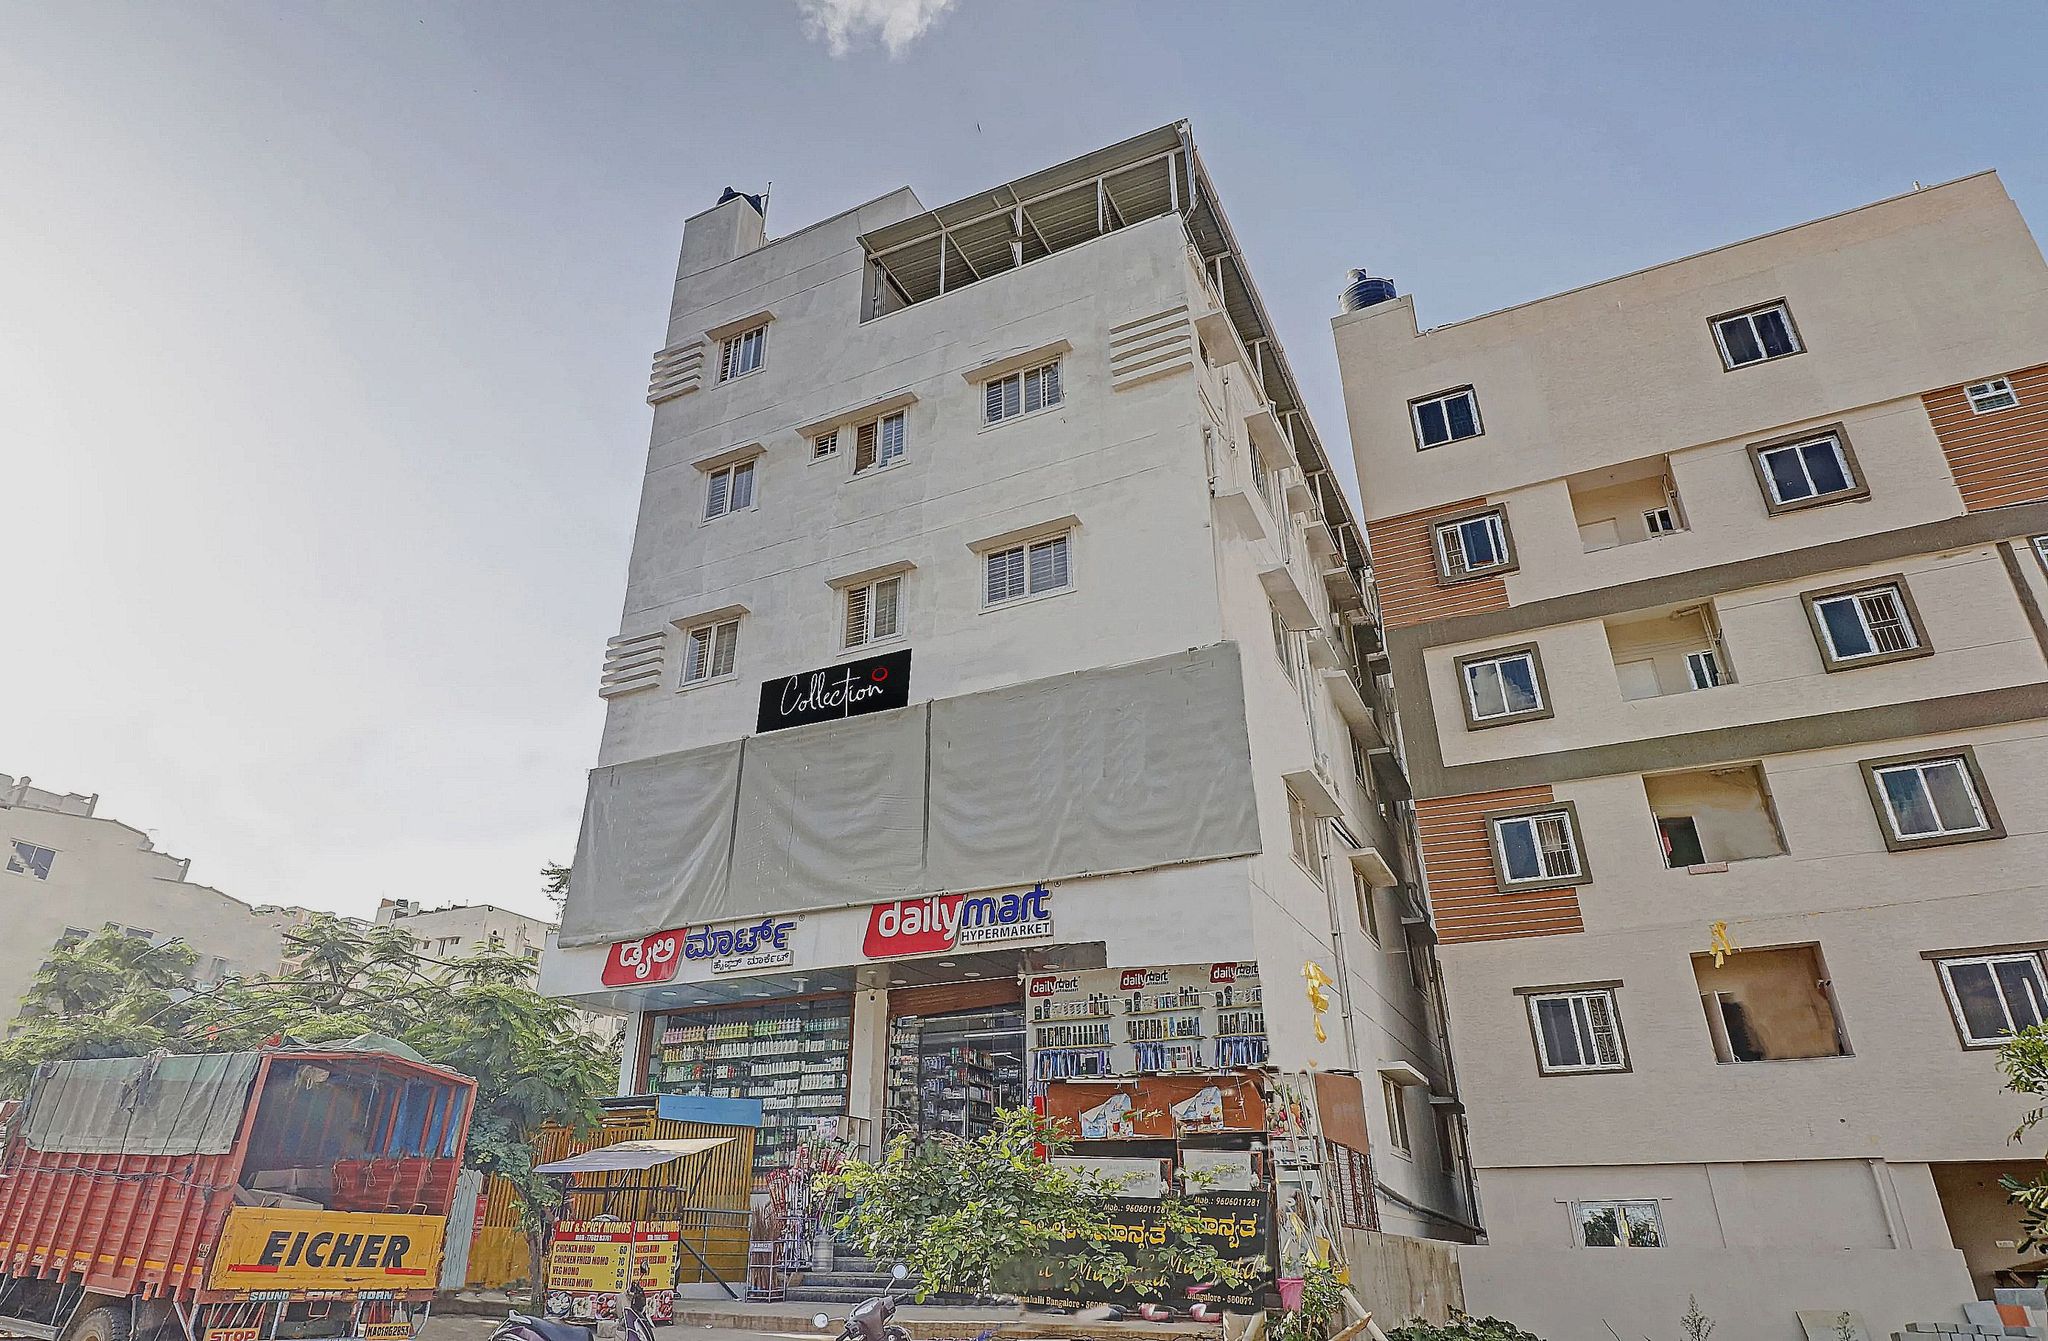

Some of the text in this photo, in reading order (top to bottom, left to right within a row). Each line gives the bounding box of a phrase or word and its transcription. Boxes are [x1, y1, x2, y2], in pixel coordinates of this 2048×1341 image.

[780, 667, 884, 718] Collection
[961, 922, 1051, 942] HYPERMARKET
[1216, 1197, 1261, 1207] 9606011281
[560, 1221, 632, 1234] HOT & SPICY MOMOS
[256, 1230, 411, 1268] EICHER
[555, 1244, 578, 1253] CHICKEN
[578, 1245, 596, 1254] MOMO
[554, 1255, 577, 1264] CHICKEN
[577, 1256, 591, 1265] FRIED
[592, 1256, 609, 1266] MOMO
[552, 1265, 562, 1274] VEG
[563, 1266, 580, 1275] MOMO
[551, 1277, 560, 1286] VEG
[561, 1278, 576, 1286] FRIED
[576, 1278, 593, 1288] MOMO
[250, 1290, 290, 1301] SOUND
[357, 1290, 393, 1300] HORN
[1046, 1296, 1080, 1309] Bangalore
[210, 1330, 256, 1341] STOP
